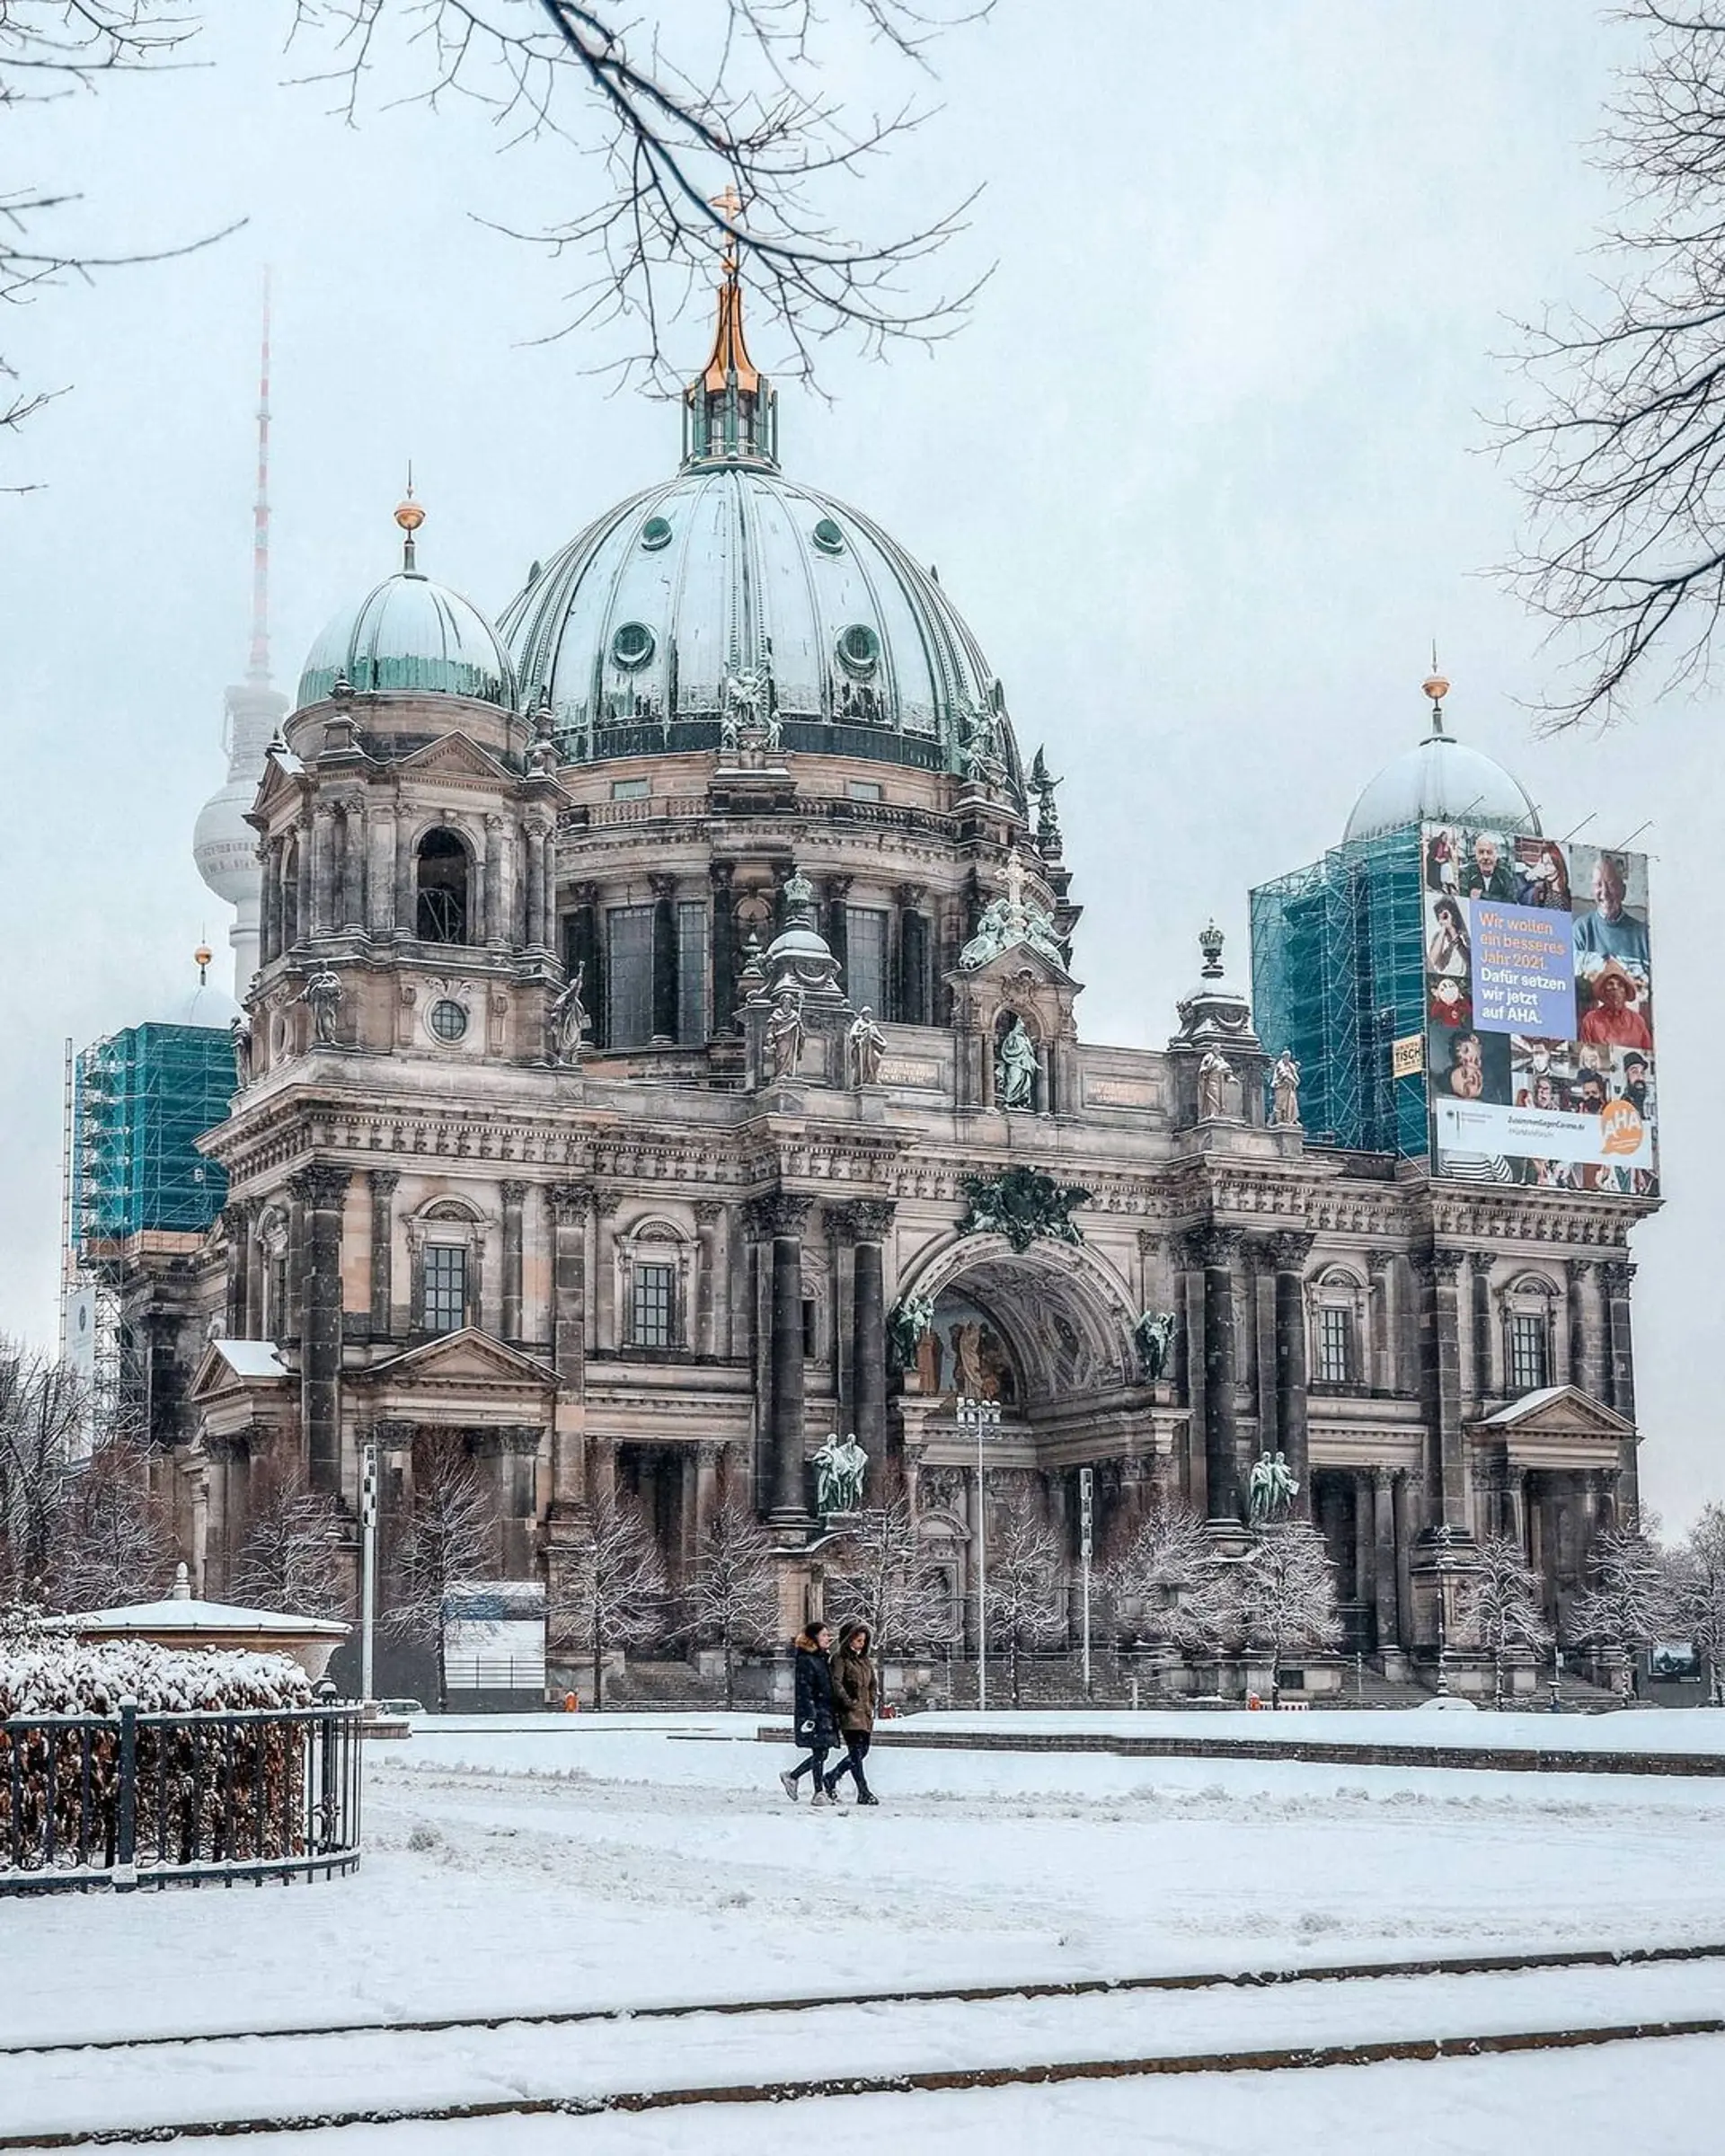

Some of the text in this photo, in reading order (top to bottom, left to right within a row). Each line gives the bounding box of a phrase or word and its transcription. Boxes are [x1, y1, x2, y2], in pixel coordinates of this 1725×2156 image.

[1479, 911, 1553, 935] Wir wollen
[1480, 931, 1566, 956] ein besseres
[1481, 950, 1548, 970] Jahr 2021.
[1481, 968, 1566, 992] Dafür setzen
[1482, 986, 1539, 1006] wir jetzt
[1482, 1005, 1543, 1024] auf AHA.
[1602, 1108, 1641, 1137] AHA
